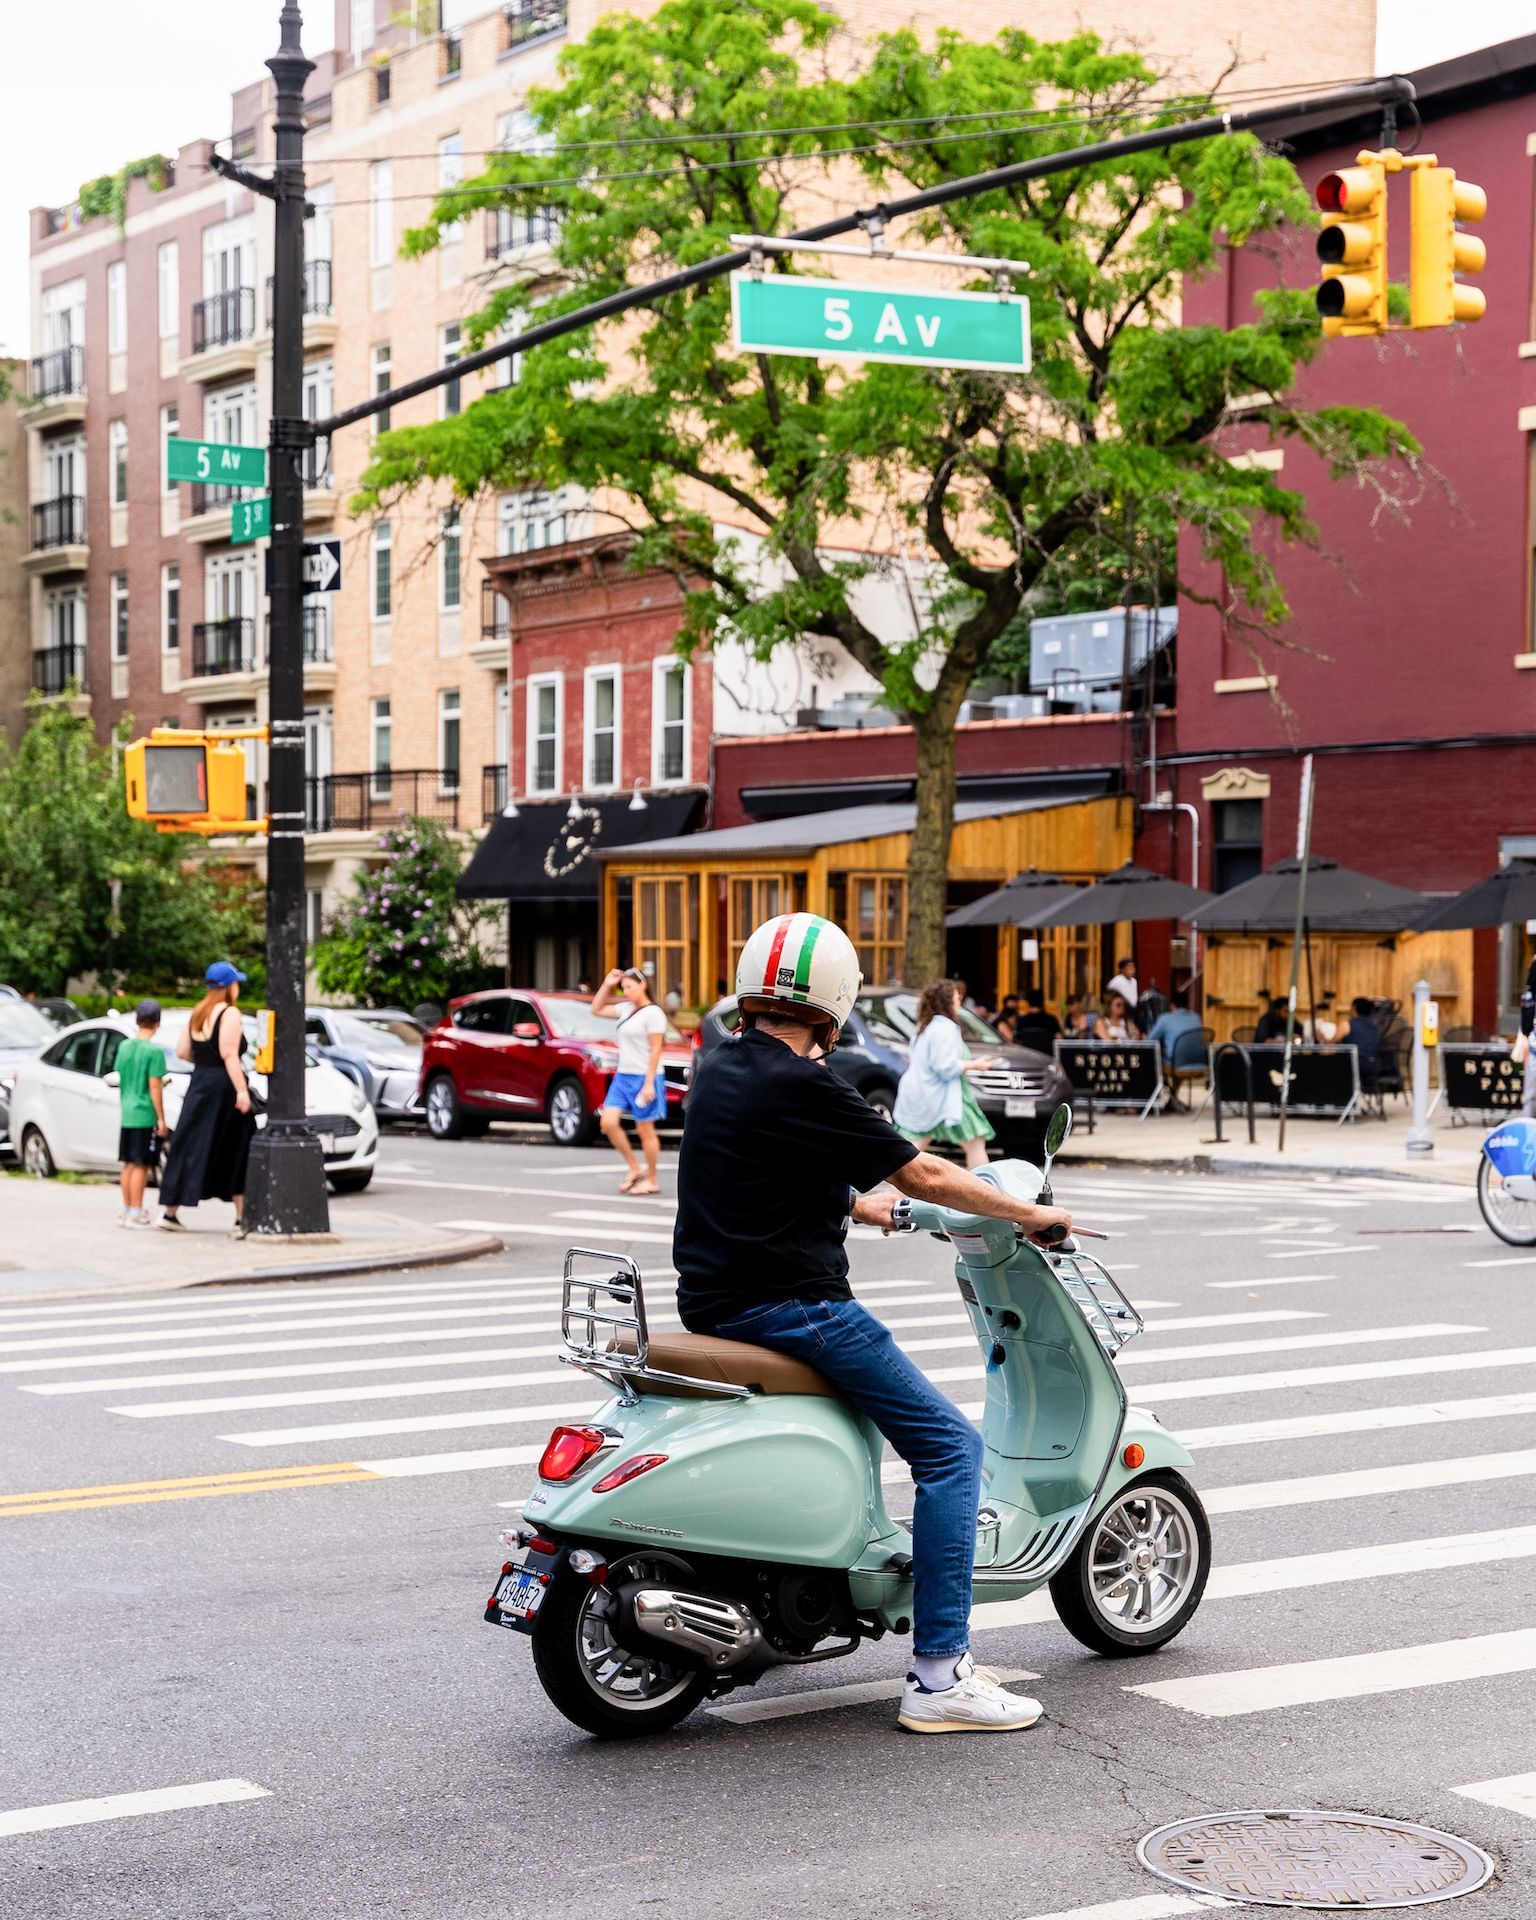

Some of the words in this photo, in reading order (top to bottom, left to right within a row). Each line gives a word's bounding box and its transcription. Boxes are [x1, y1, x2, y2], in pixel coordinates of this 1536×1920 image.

[823, 297, 853, 342] 5
[874, 302, 942, 348] Av
[196, 446, 211, 479] 5
[243, 505, 252, 537] 3
[1074, 1054, 1141, 1069] STONE
[1086, 1069, 1130, 1082] PARK
